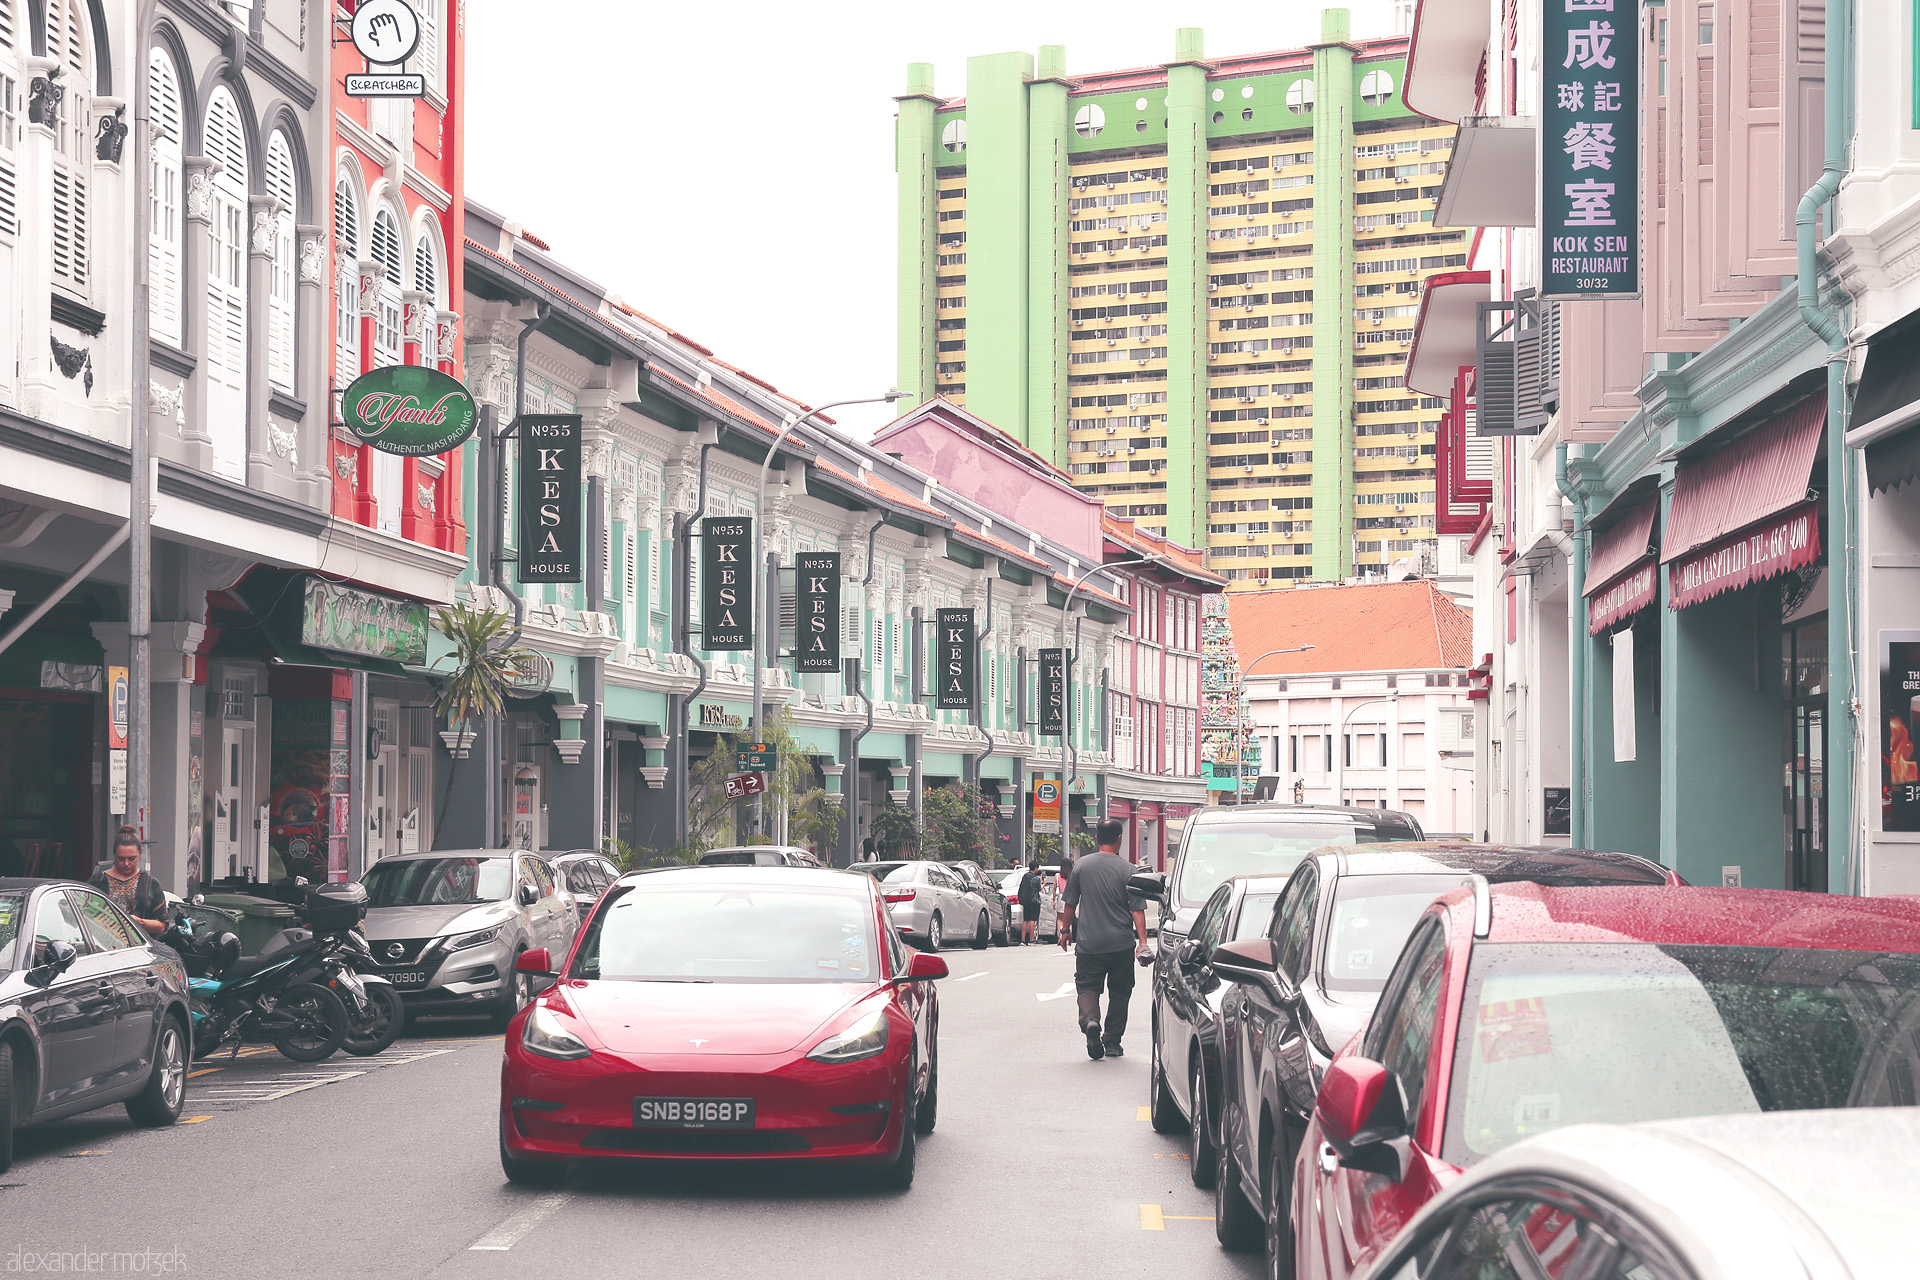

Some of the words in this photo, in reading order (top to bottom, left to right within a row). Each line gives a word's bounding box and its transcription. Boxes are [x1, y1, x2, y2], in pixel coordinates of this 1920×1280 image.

[351, 80, 419, 90] SCRATCHBAC
[1557, 81, 1622, 112] 球記
[1563, 122, 1616, 226] 餐室
[1553, 236, 1588, 253] KOK
[1593, 236, 1627, 252] SEN
[1552, 257, 1628, 273] RESTAURANT
[1576, 278, 1608, 289] 30/32
[356, 391, 467, 437] Yanti
[376, 439, 426, 454] AUTHENTIC
[427, 438, 448, 452] NASI
[448, 410, 473, 444] PADANG
[1703, 553, 1717, 584] GAS
[1732, 541, 1747, 573] LTD
[1750, 533, 1769, 566] TEL:
[1770, 524, 1788, 559] 6567
[530, 564, 570, 573] HOUSE
[712, 635, 744, 643] HOUSE
[1906, 786, 1913, 801] 3
